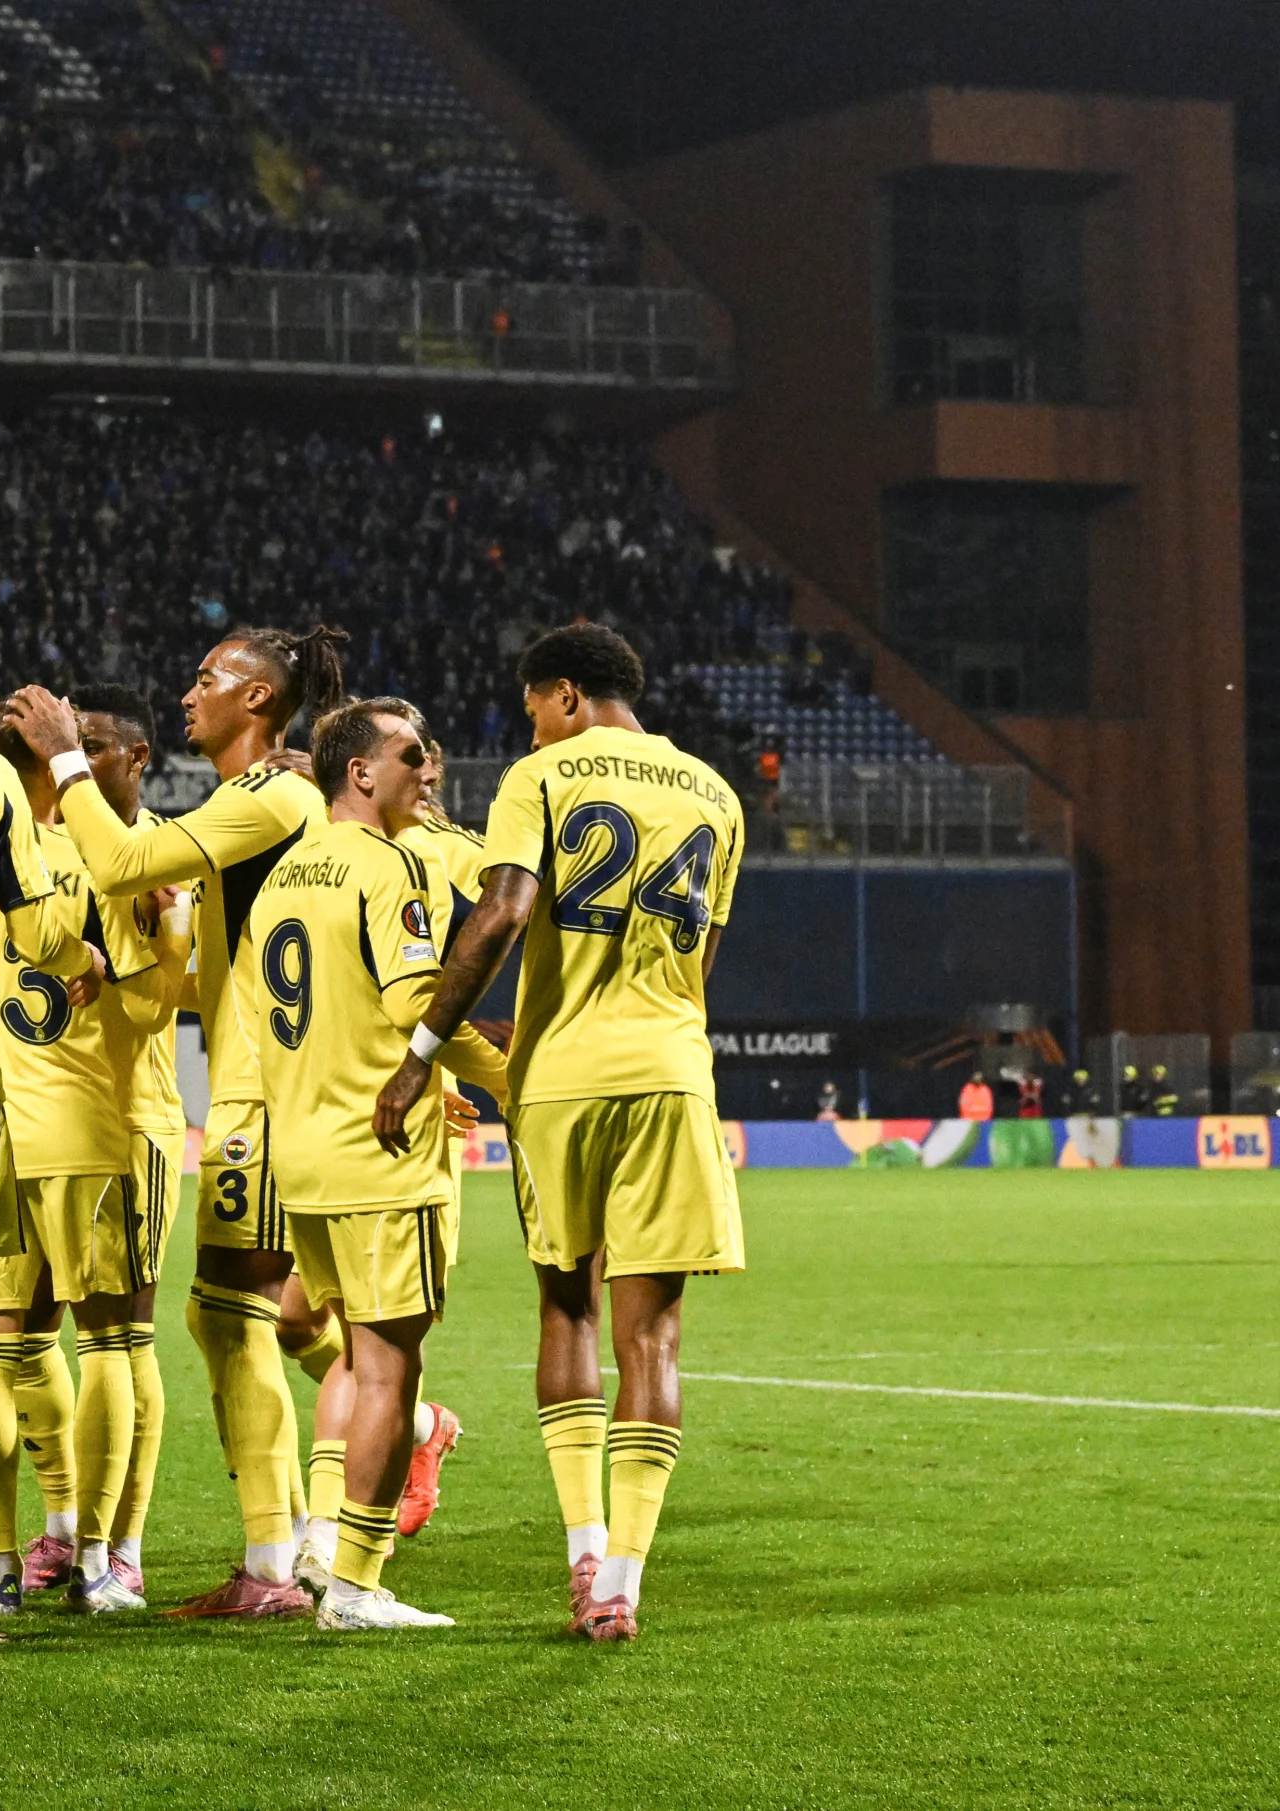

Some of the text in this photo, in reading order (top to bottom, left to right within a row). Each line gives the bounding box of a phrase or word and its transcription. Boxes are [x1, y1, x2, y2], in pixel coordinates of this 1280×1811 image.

[557, 755, 729, 814] OOSTERWOLDE
[52, 869, 81, 897] KI
[551, 801, 716, 954] 24
[262, 918, 312, 1050] 9
[709, 1031, 832, 1056] PA LEAGUE
[214, 1169, 249, 1222] 3
